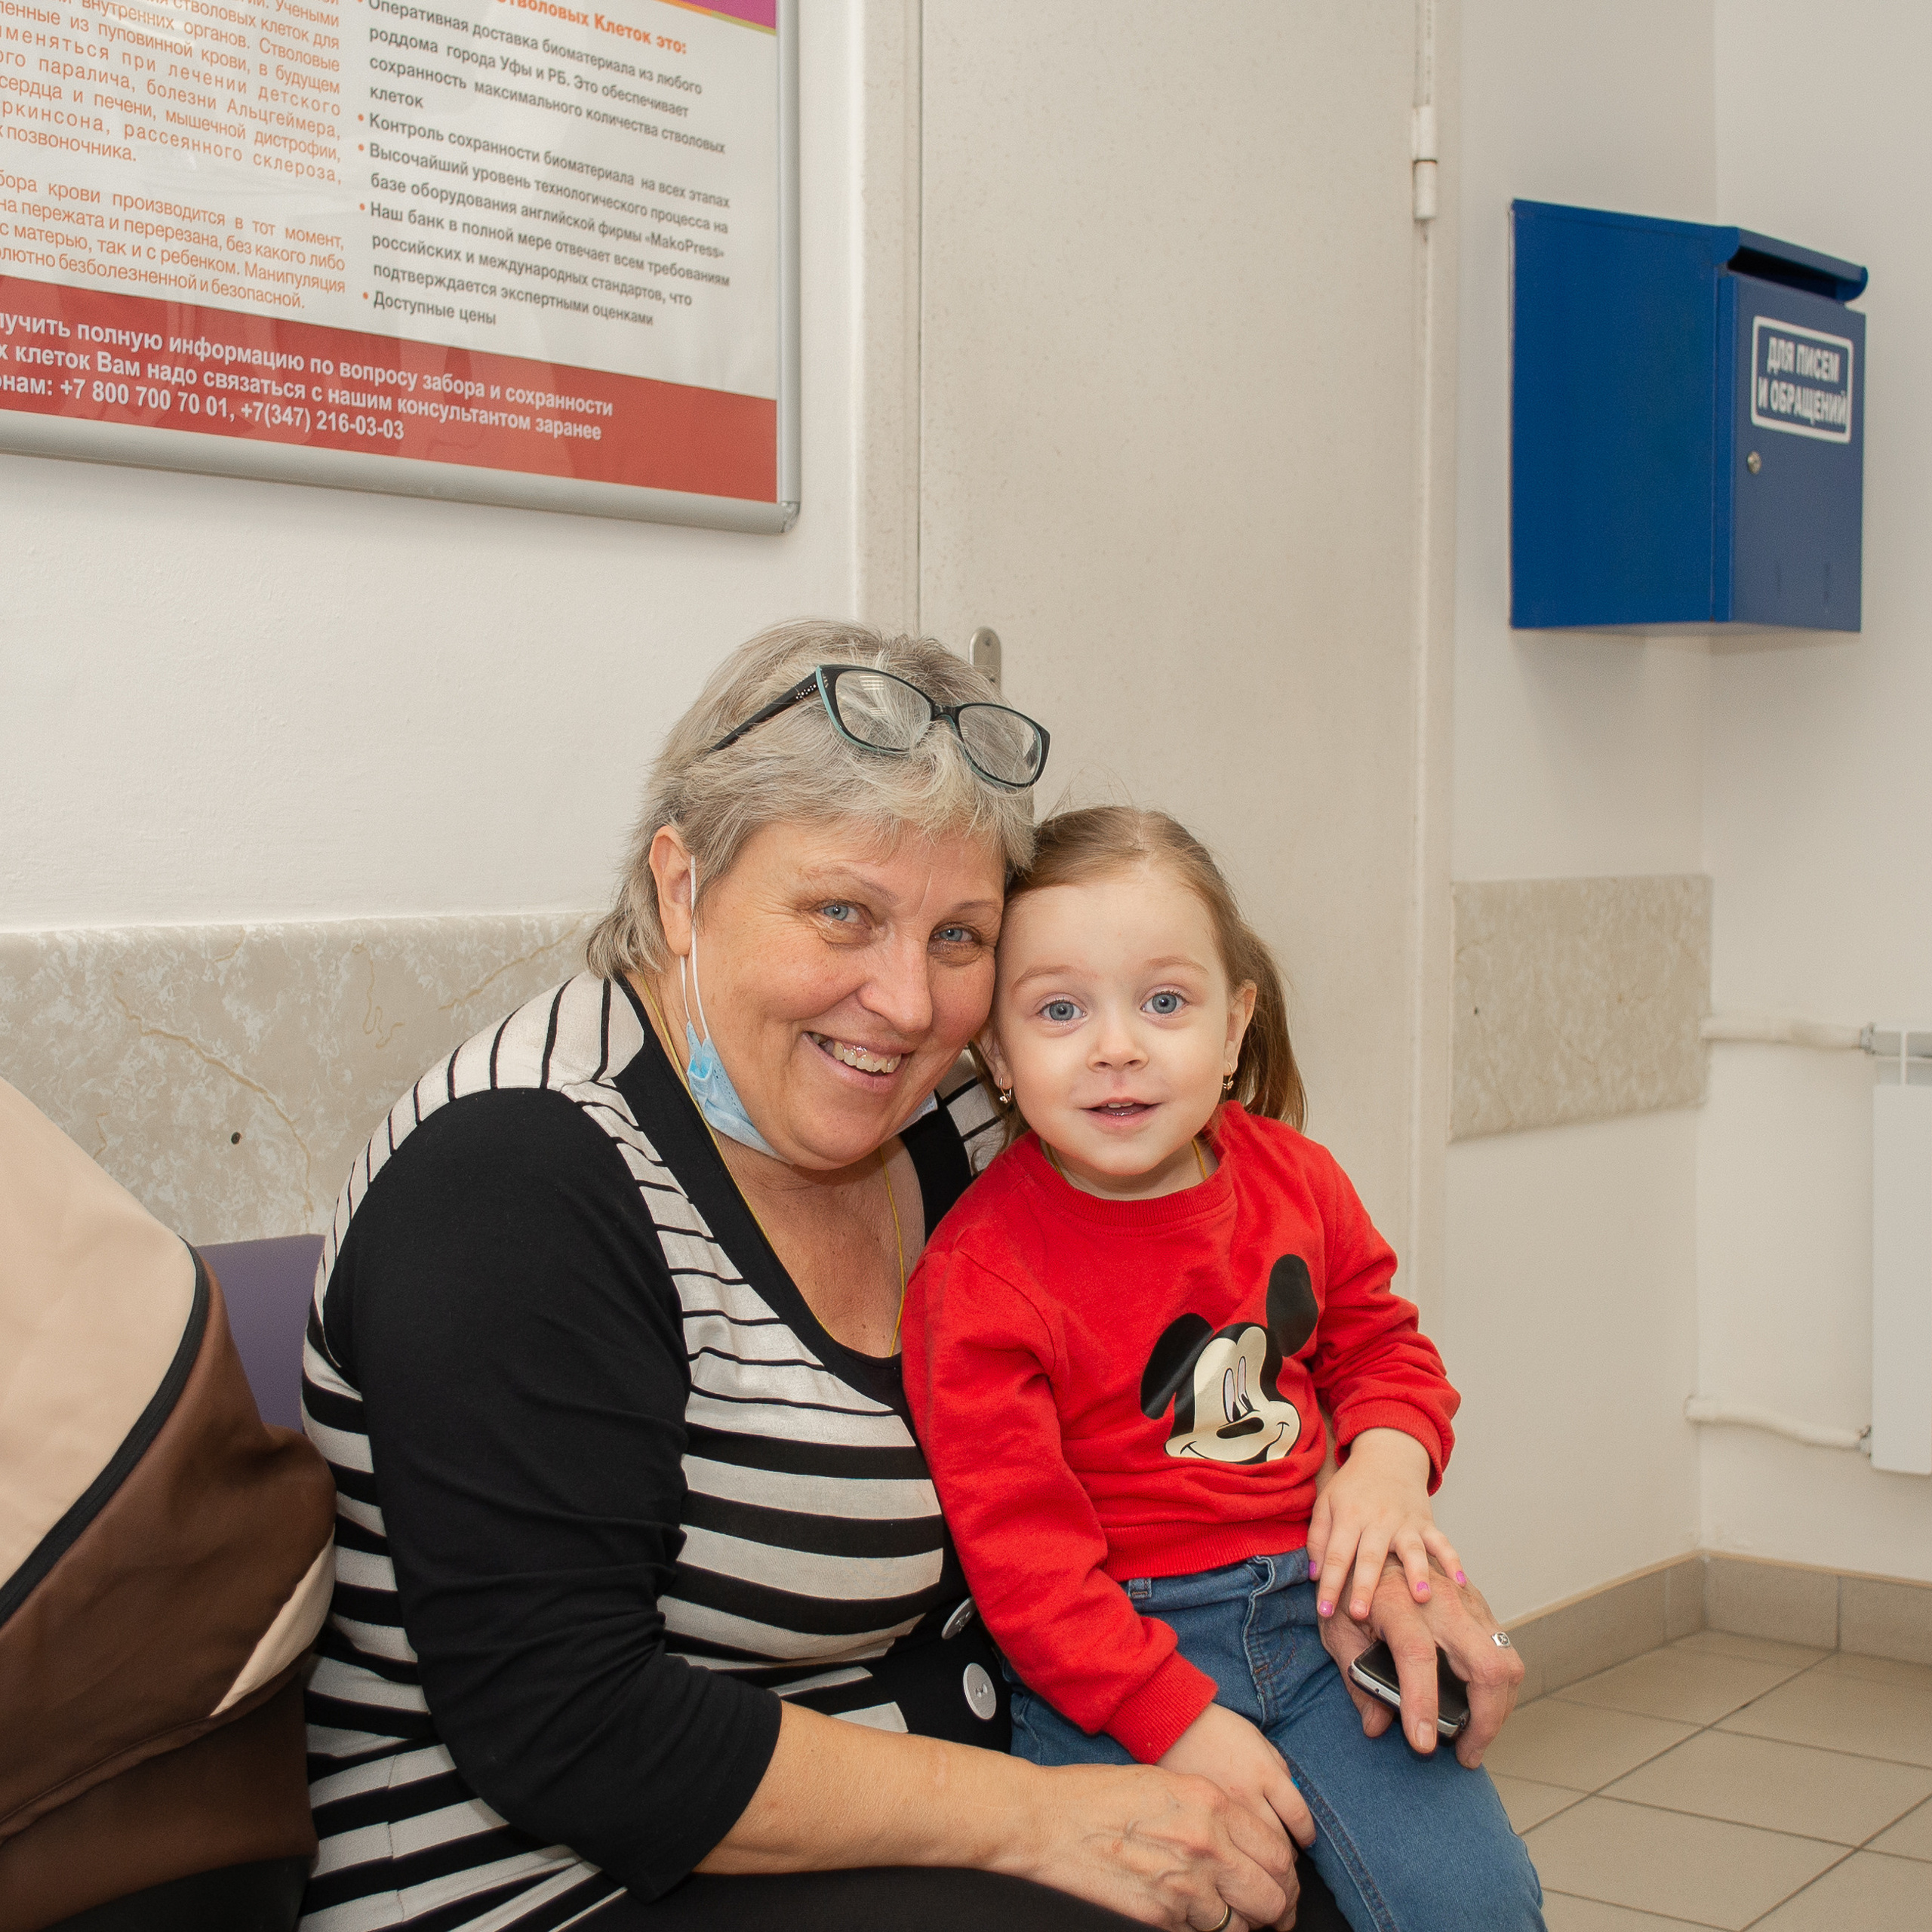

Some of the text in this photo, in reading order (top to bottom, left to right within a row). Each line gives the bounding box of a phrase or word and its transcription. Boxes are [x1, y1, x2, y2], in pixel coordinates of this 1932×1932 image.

[82, 0, 339, 72] внутренних органов. Стволовые
[174, 0, 339, 49] стволовых клеток для
[275, 0, 339, 27] Учеными
[368, 0, 703, 95] Оперативная доставка биоматериала из любого
[497, 0, 686, 54] воловых Клеток это:
[0, 25, 340, 115] меняться при лечении детского
[70, 16, 89, 32] из
[98, 23, 192, 57] пуповинной
[202, 48, 250, 74] крови,
[260, 63, 268, 76] в
[275, 64, 339, 94] будущем
[369, 26, 688, 118] роддома города Уфы и РБ. Это обеспечивает
[0, 75, 340, 162] сердца и печени, мышечной дистрофии,
[39, 58, 135, 93] паралича,
[147, 78, 217, 110] болезни
[227, 98, 340, 140] Альцгеймера,
[369, 57, 725, 154] сохранность максимального количества стволовых
[370, 86, 423, 109] клеток
[7, 125, 137, 162] позвоночника.
[124, 123, 242, 161] рассеянного
[254, 153, 341, 185] склероза,
[369, 112, 730, 208] Контроль сохранности биоматериала на всех этапах
[48, 183, 100, 203] крови
[112, 192, 225, 226] производится
[235, 217, 243, 229] в
[252, 220, 275, 235] тот
[285, 227, 344, 251] момент,
[370, 142, 728, 234] Высочайший уровень технологического процесса на
[371, 172, 406, 192] базе
[411, 182, 517, 214] оборудования
[521, 204, 595, 232] английской
[598, 219, 641, 242] фирмы
[0, 222, 345, 294] с матерью, так и с ребенком. Манипуляция
[21, 201, 104, 228] пережата
[109, 217, 118, 230] и
[124, 219, 222, 251] перерезана,
[226, 235, 251, 254] без
[255, 244, 305, 264] какого
[309, 252, 345, 271] либо
[371, 202, 730, 287] Наш банк в полной мере отвечает всем требованиям
[373, 235, 692, 306] российских и международных стандартов, что
[0, 246, 305, 309] лютно безболезненной и безопасной.
[374, 263, 654, 327] подтверждается экспертными оценками
[374, 290, 497, 325] Доступные цены
[15, 345, 90, 371] клеток
[97, 350, 140, 377] Вам
[147, 362, 197, 386] надо
[203, 371, 305, 399] связаться
[312, 385, 322, 401] с
[328, 388, 392, 411] нашим
[398, 397, 530, 429] консультантом
[535, 417, 601, 440] заранее
[77, 323, 163, 352] полную
[169, 336, 305, 371] информацию
[310, 357, 334, 376] по
[340, 361, 418, 392] вопросу
[423, 374, 485, 400] забора
[490, 383, 500, 400] и
[506, 386, 613, 417] сохранности
[1767, 337, 1841, 384] ДЛЯ ПИСЕМ
[0, 374, 405, 440] нам: +7 800 700 70 01, +7(347) 216-03-03
[1758, 376, 1848, 426] И ОБРАЩЕНИЙ
